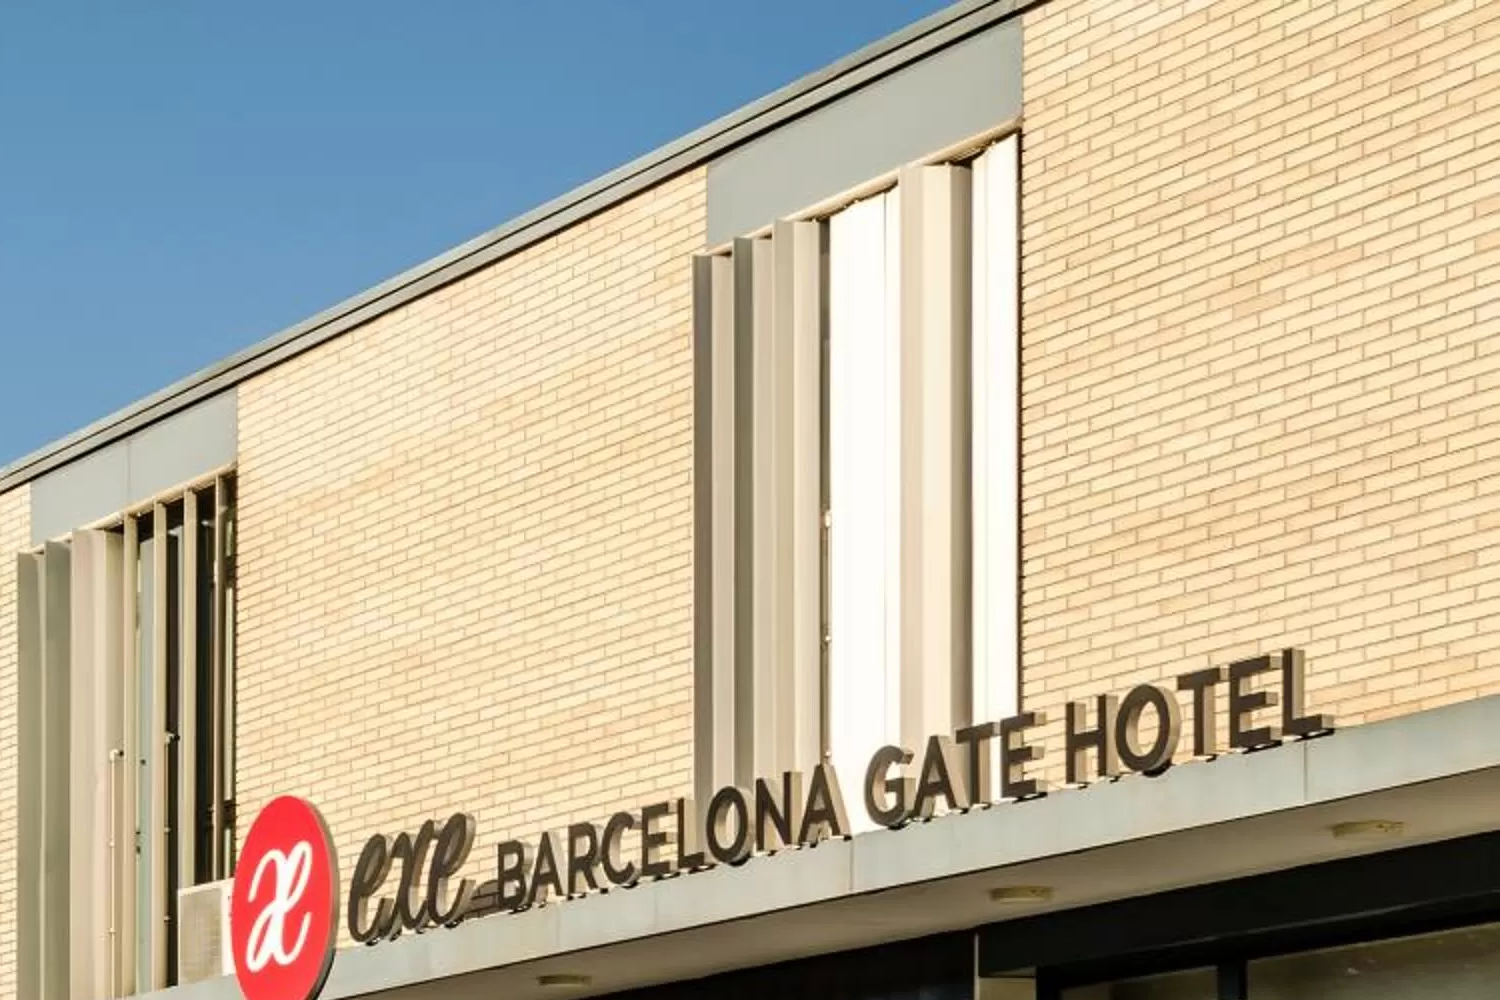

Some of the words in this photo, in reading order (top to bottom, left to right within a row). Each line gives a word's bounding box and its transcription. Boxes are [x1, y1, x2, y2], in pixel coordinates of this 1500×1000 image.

[348, 812, 476, 943] exe
[497, 764, 851, 910] BARCELONA
[864, 711, 1045, 827] GATE
[1065, 648, 1333, 785] HOTEL
